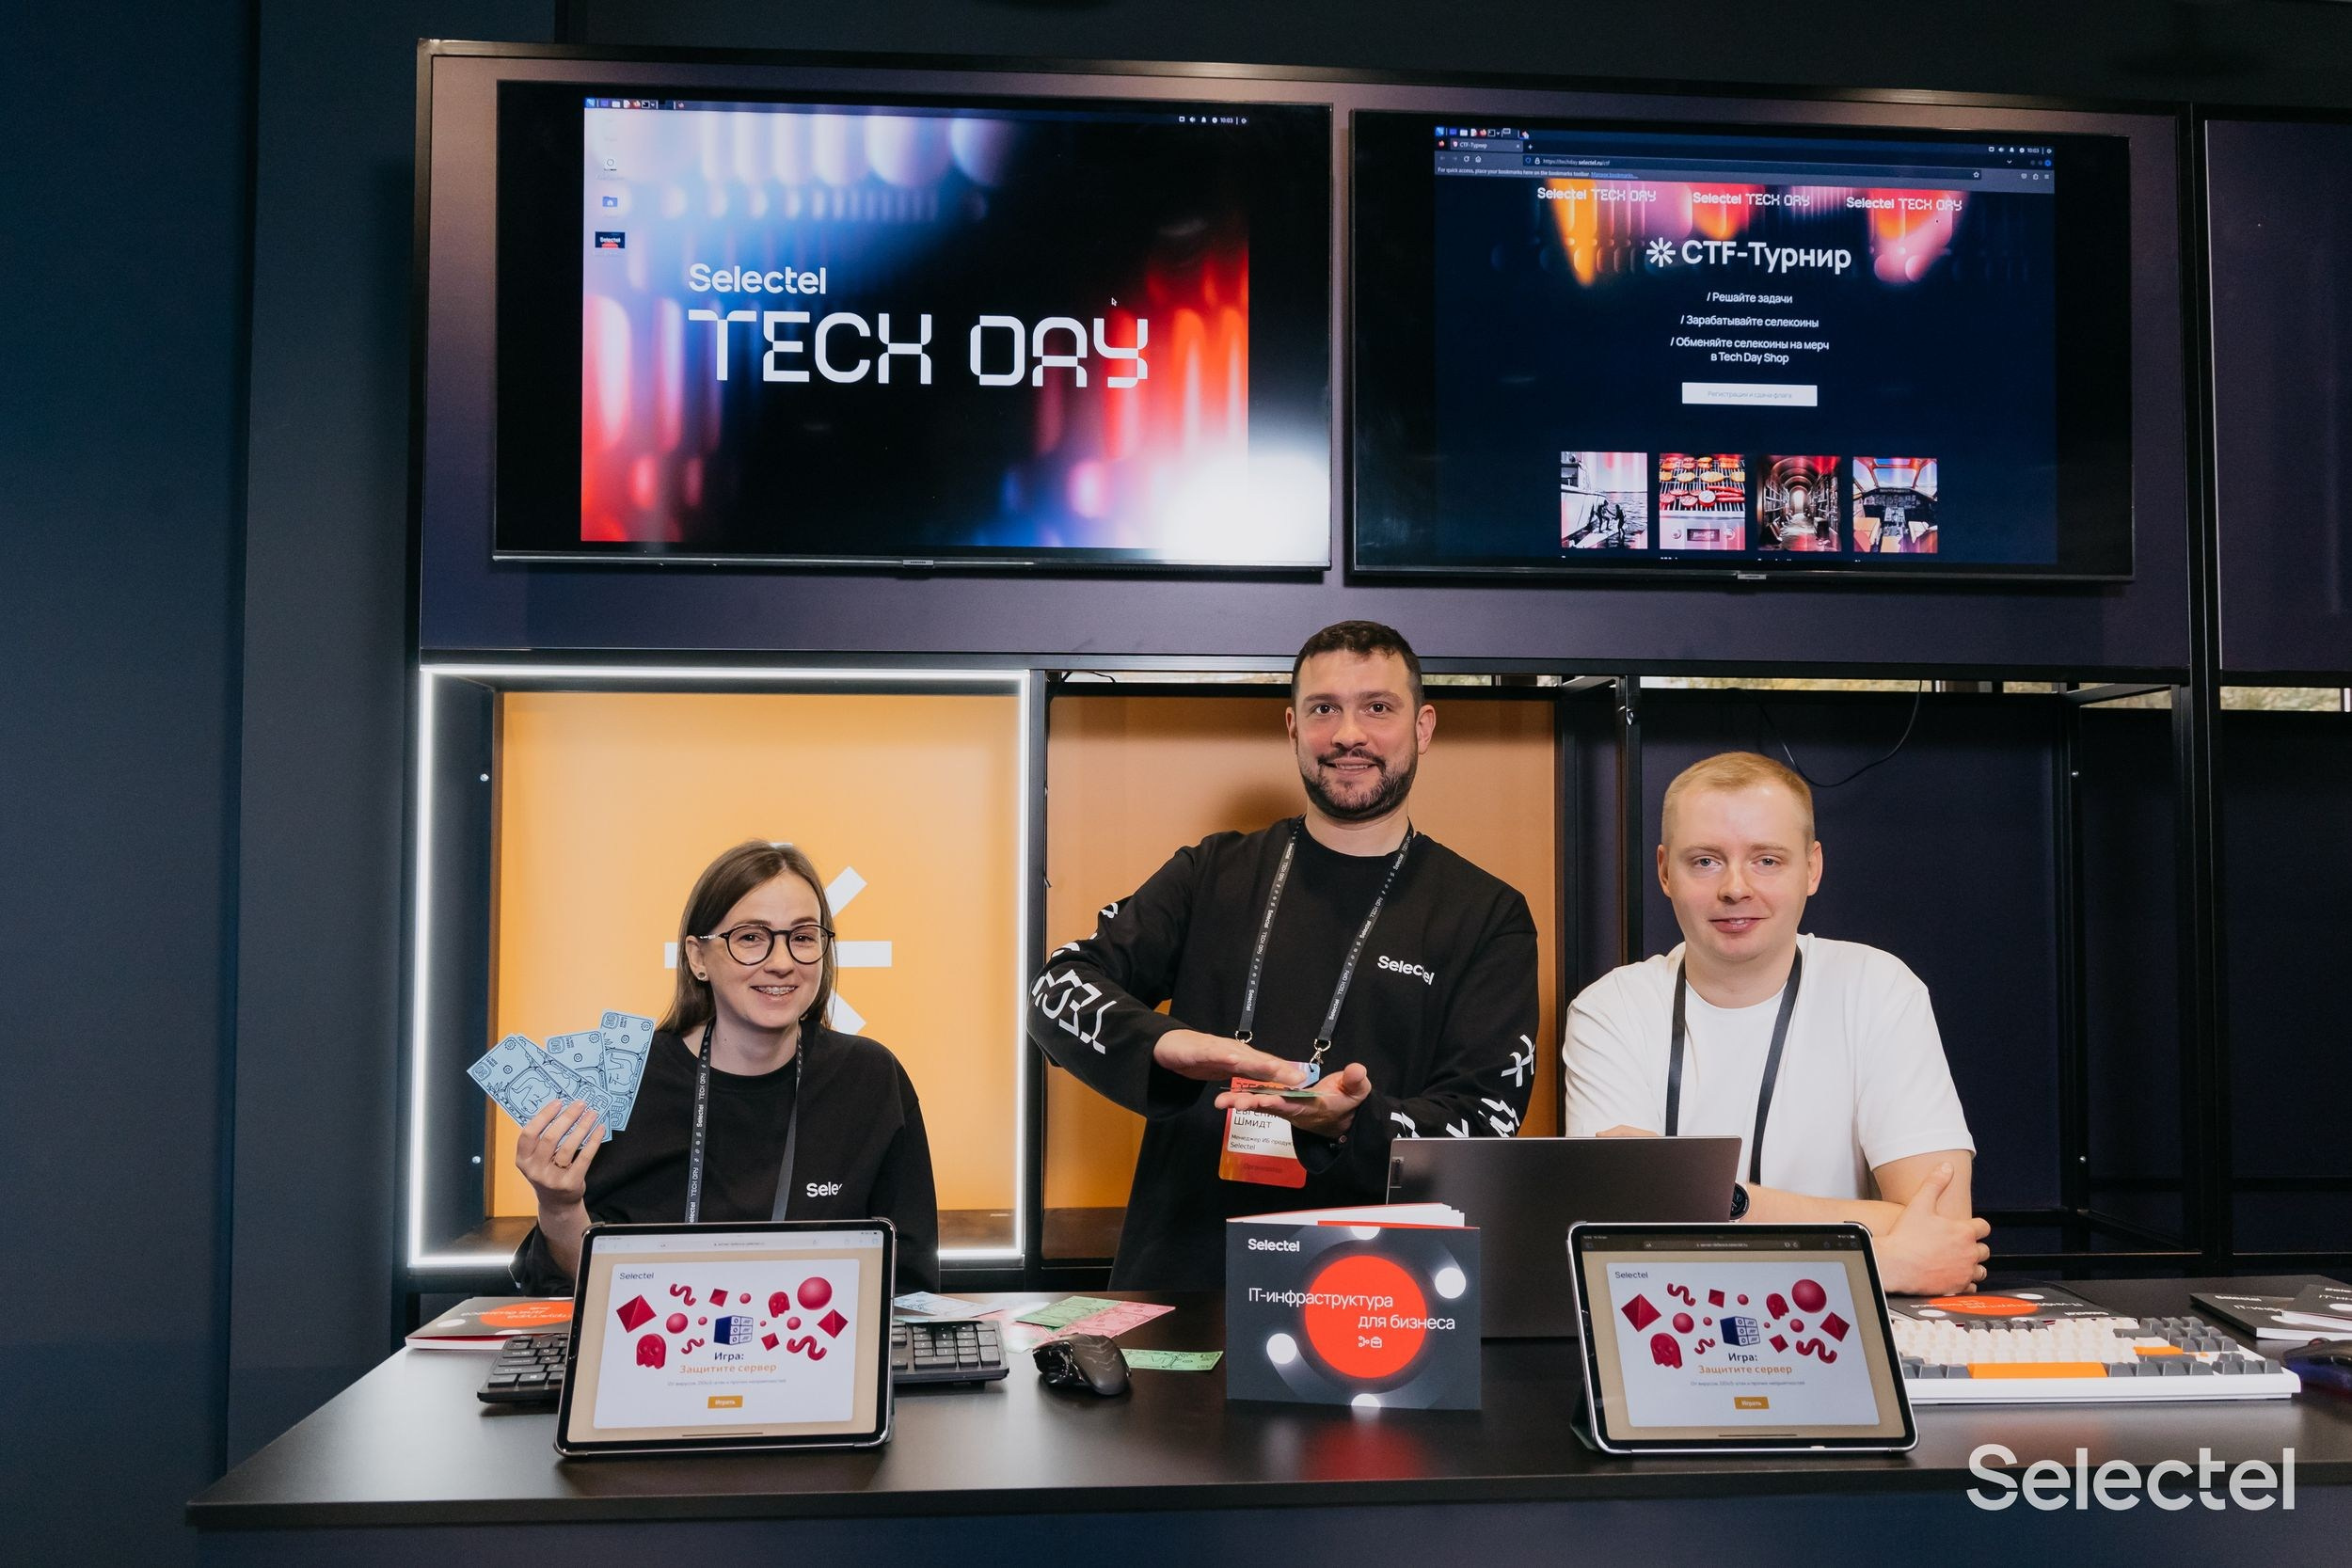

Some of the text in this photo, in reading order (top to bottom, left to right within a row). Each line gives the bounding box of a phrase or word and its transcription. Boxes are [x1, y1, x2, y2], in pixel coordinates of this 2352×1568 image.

[1537, 187, 1656, 202] Selectel TECH DAY
[1693, 192, 1810, 207] Selectel TECH DAY
[1847, 197, 1962, 212] Selectel TECH DAY
[1681, 240, 1851, 275] CTF-Турнир
[689, 263, 826, 294] Selectel
[1712, 292, 1756, 303] Решайте
[1757, 293, 1793, 304] задачи
[1686, 315, 1763, 327] Зарабатывайте
[1764, 318, 1820, 327] селекоины
[688, 309, 1148, 388] TECH DAY
[1676, 337, 1733, 348] Обменяйте
[1734, 340, 1788, 349] селекоины
[1804, 341, 1829, 352] мерч
[1710, 352, 1789, 365] в Tech Day Shop
[1377, 955, 1435, 985] Selecel
[1233, 1116, 1272, 1129] Шмидт
[1232, 1134, 1261, 1143] Менеджер
[1231, 1142, 1256, 1150] Selectel
[806, 1181, 843, 1197] Sele
[1248, 1238, 1300, 1252] Selectel
[619, 1272, 654, 1280] Selectel
[1614, 1271, 1648, 1279] Selectel
[1248, 1287, 1393, 1310] IT-инфраструктура
[1358, 1314, 1455, 1330] для бизнеса
[714, 1352, 744, 1362] Игра:
[1728, 1353, 1757, 1363] Игра:
[679, 1364, 777, 1374] Защитите сервер
[1699, 1365, 1792, 1375] Защитите сервер
